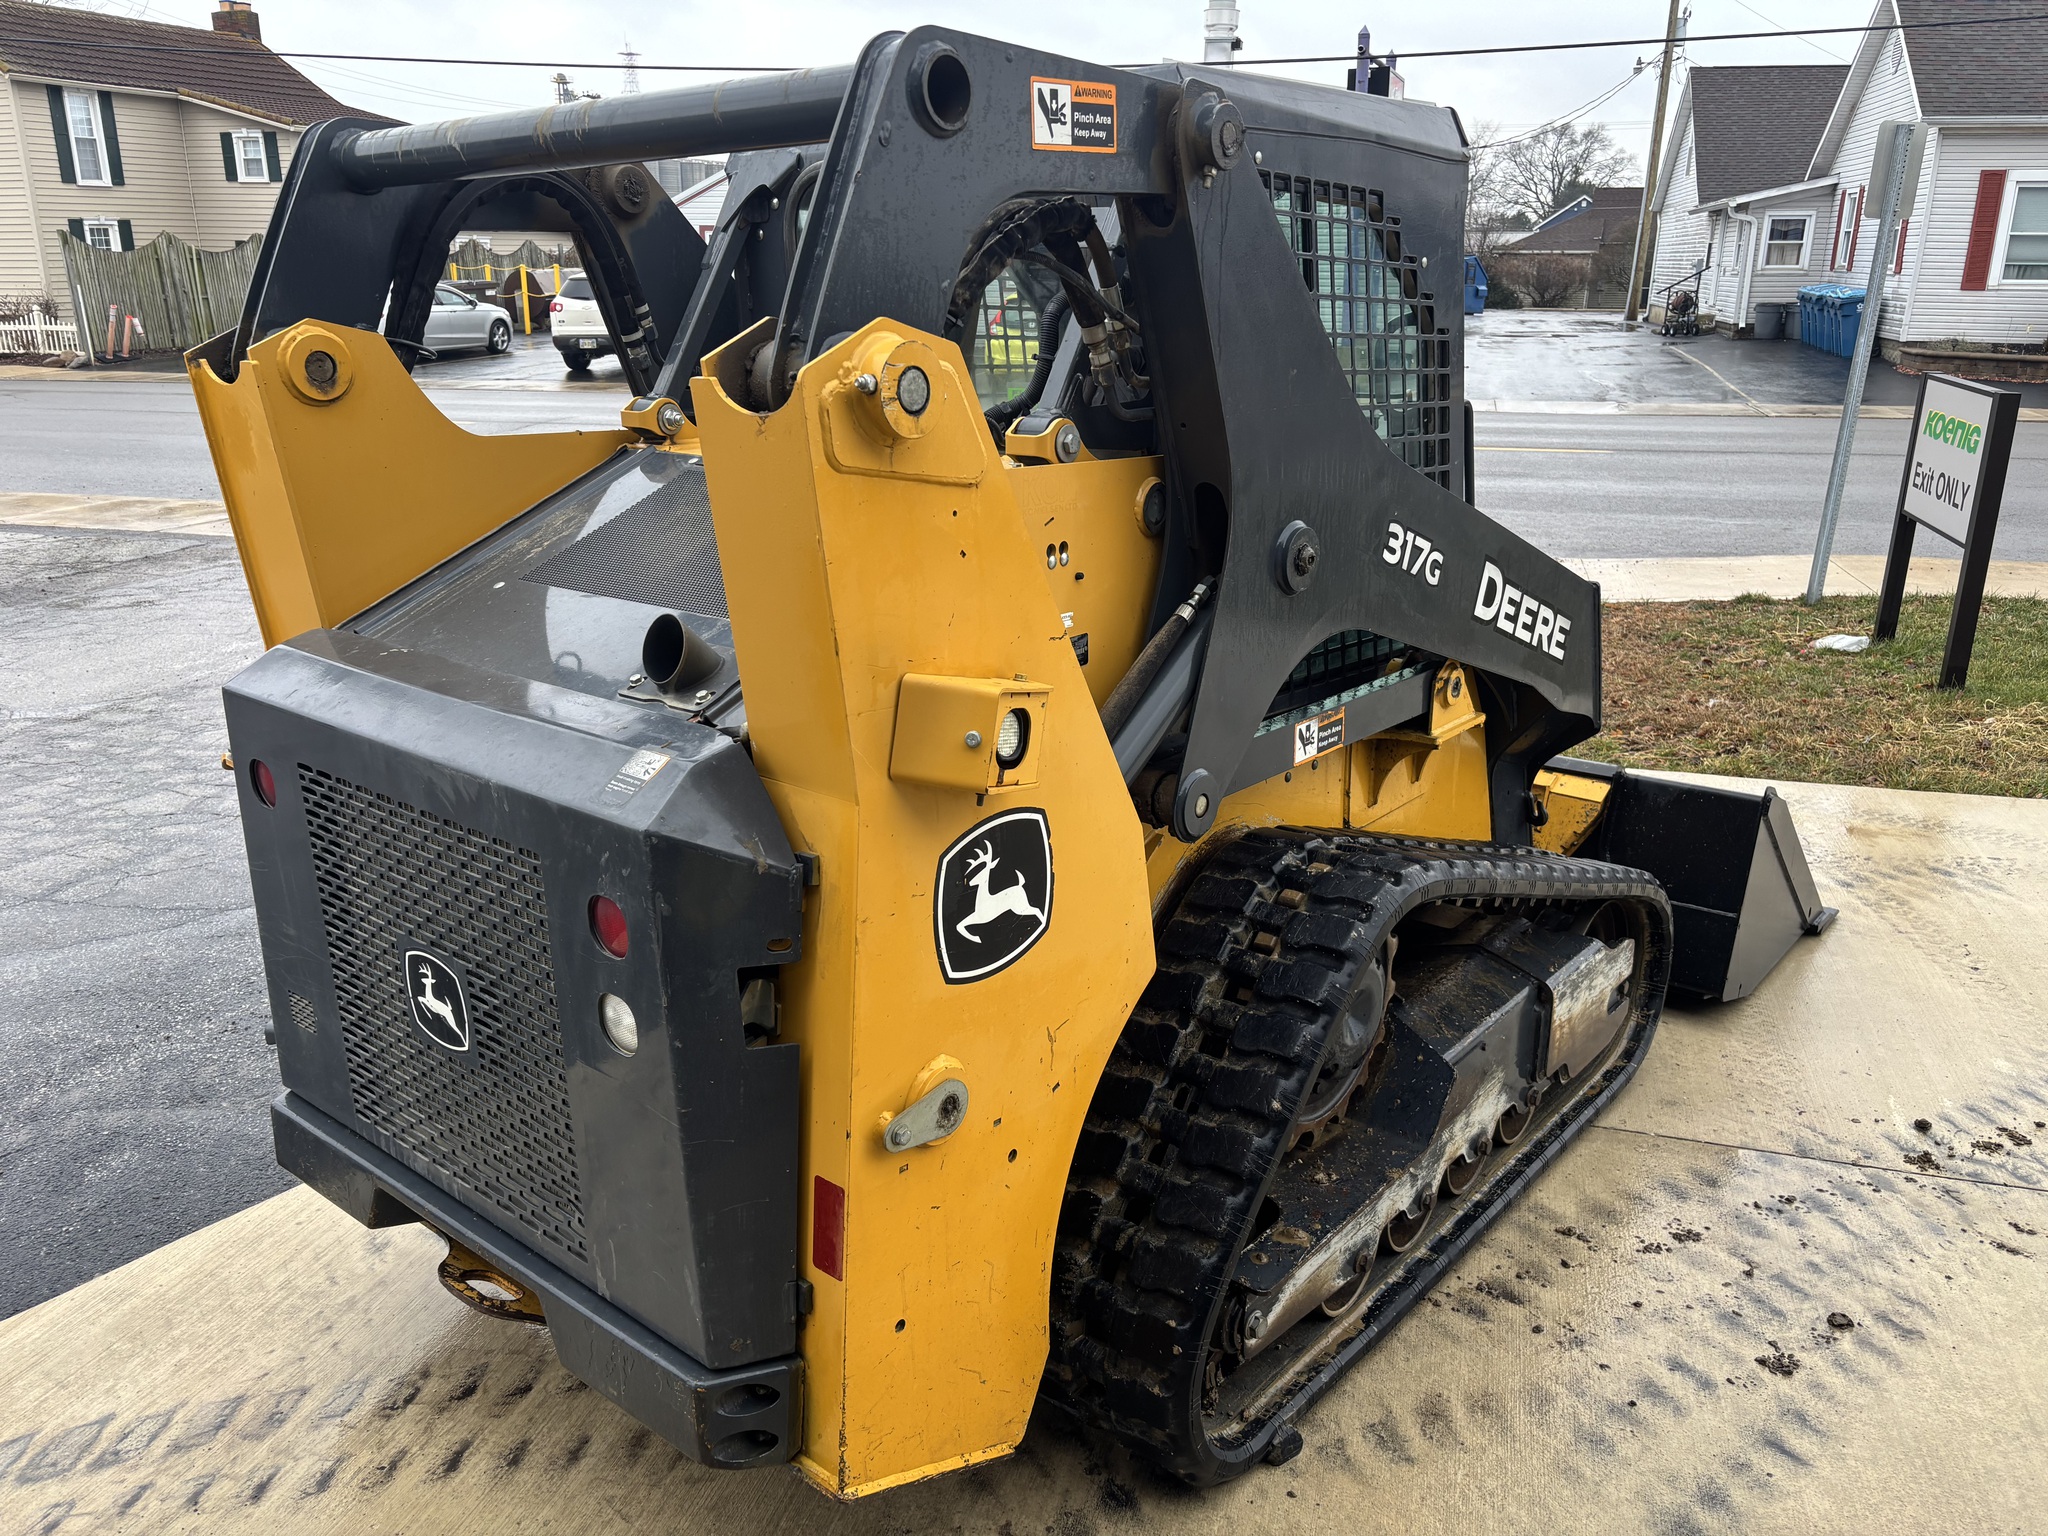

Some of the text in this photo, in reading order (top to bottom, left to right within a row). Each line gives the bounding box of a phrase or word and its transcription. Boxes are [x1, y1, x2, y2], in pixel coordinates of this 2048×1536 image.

[1081, 88, 1112, 99] WARNING
[1074, 112, 1112, 124] Pinch Area
[1074, 127, 1107, 140] Keep Away
[1912, 461, 1971, 512] Exit ONLY
[1382, 522, 1445, 586] 317G
[1473, 560, 1572, 661] DEERE
